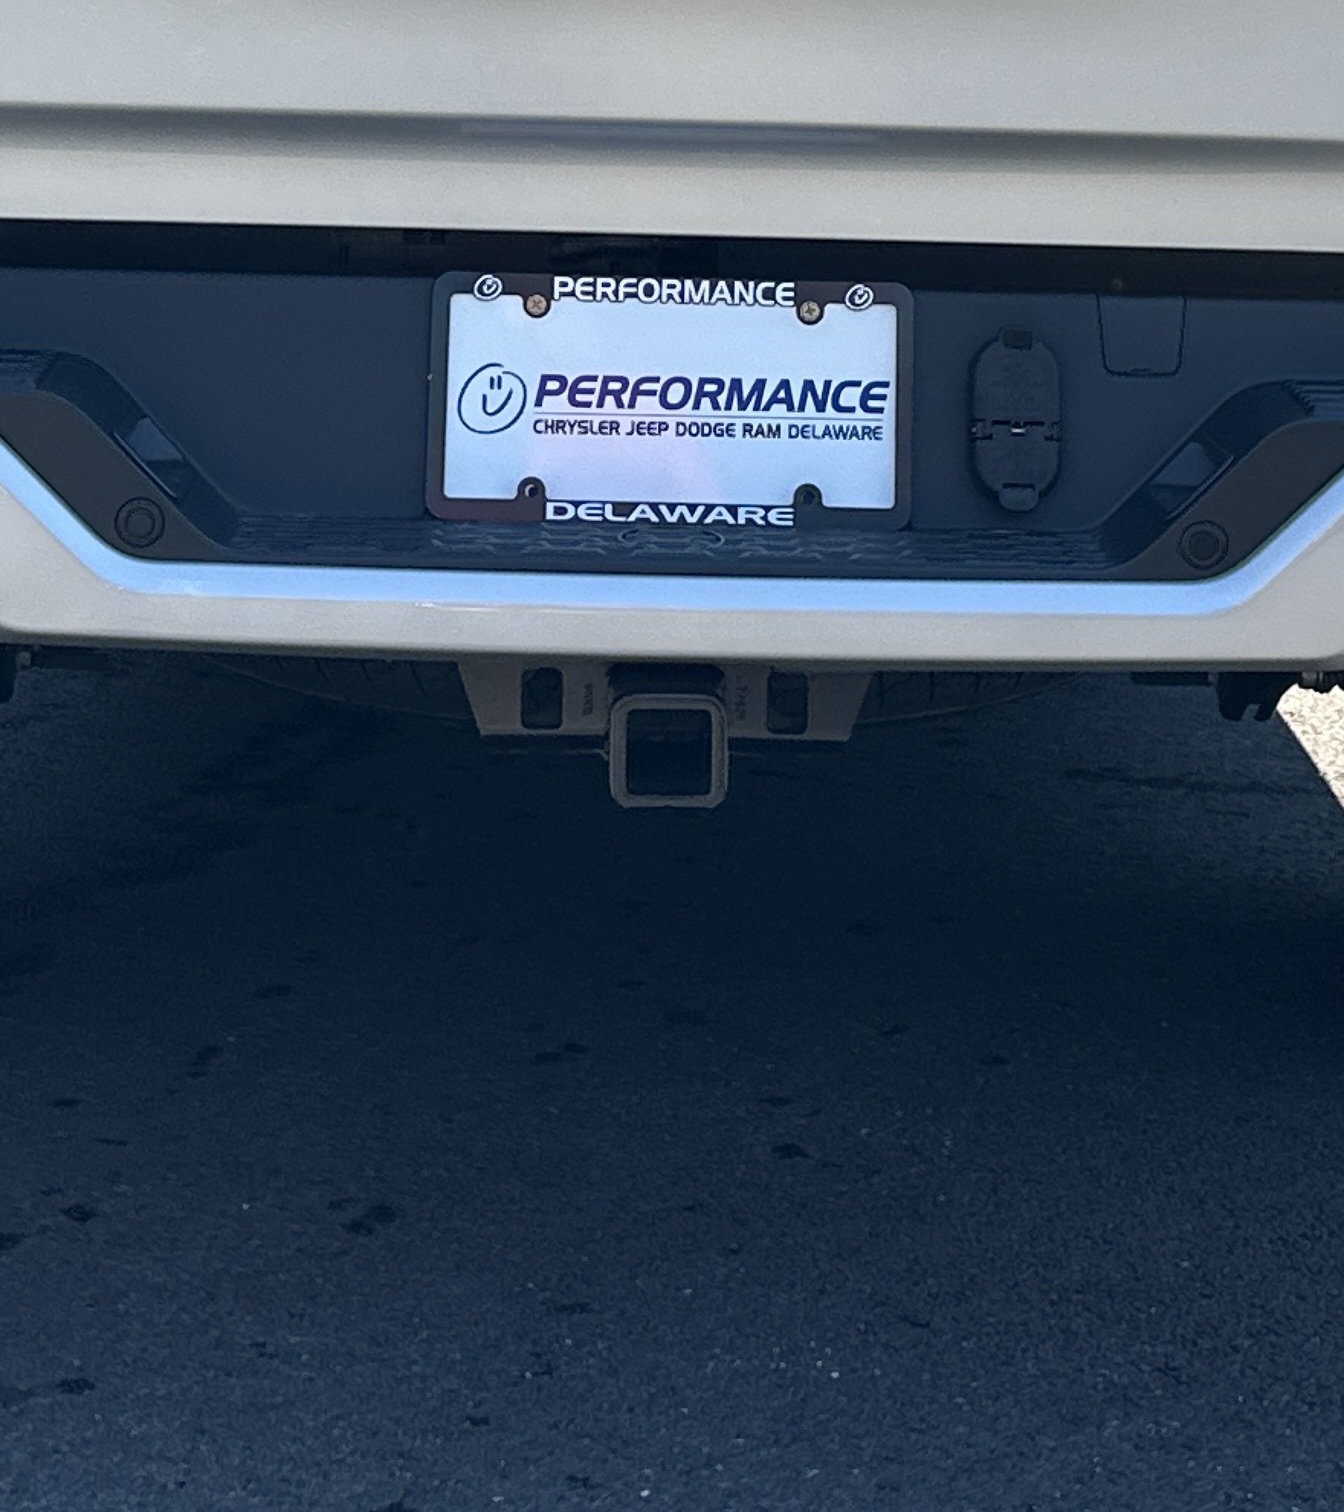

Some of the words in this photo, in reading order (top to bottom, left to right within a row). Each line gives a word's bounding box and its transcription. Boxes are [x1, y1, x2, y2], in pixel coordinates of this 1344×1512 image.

[552, 276, 797, 307] PERFORMANCE
[533, 373, 890, 414] PERFORMANCE
[532, 419, 621, 437] CHRYSLER
[625, 421, 670, 438] JEEP
[675, 422, 737, 439] DODGE
[742, 424, 782, 440] RAM
[787, 425, 884, 442] DELAWARE
[545, 502, 796, 527] DELAWARE
